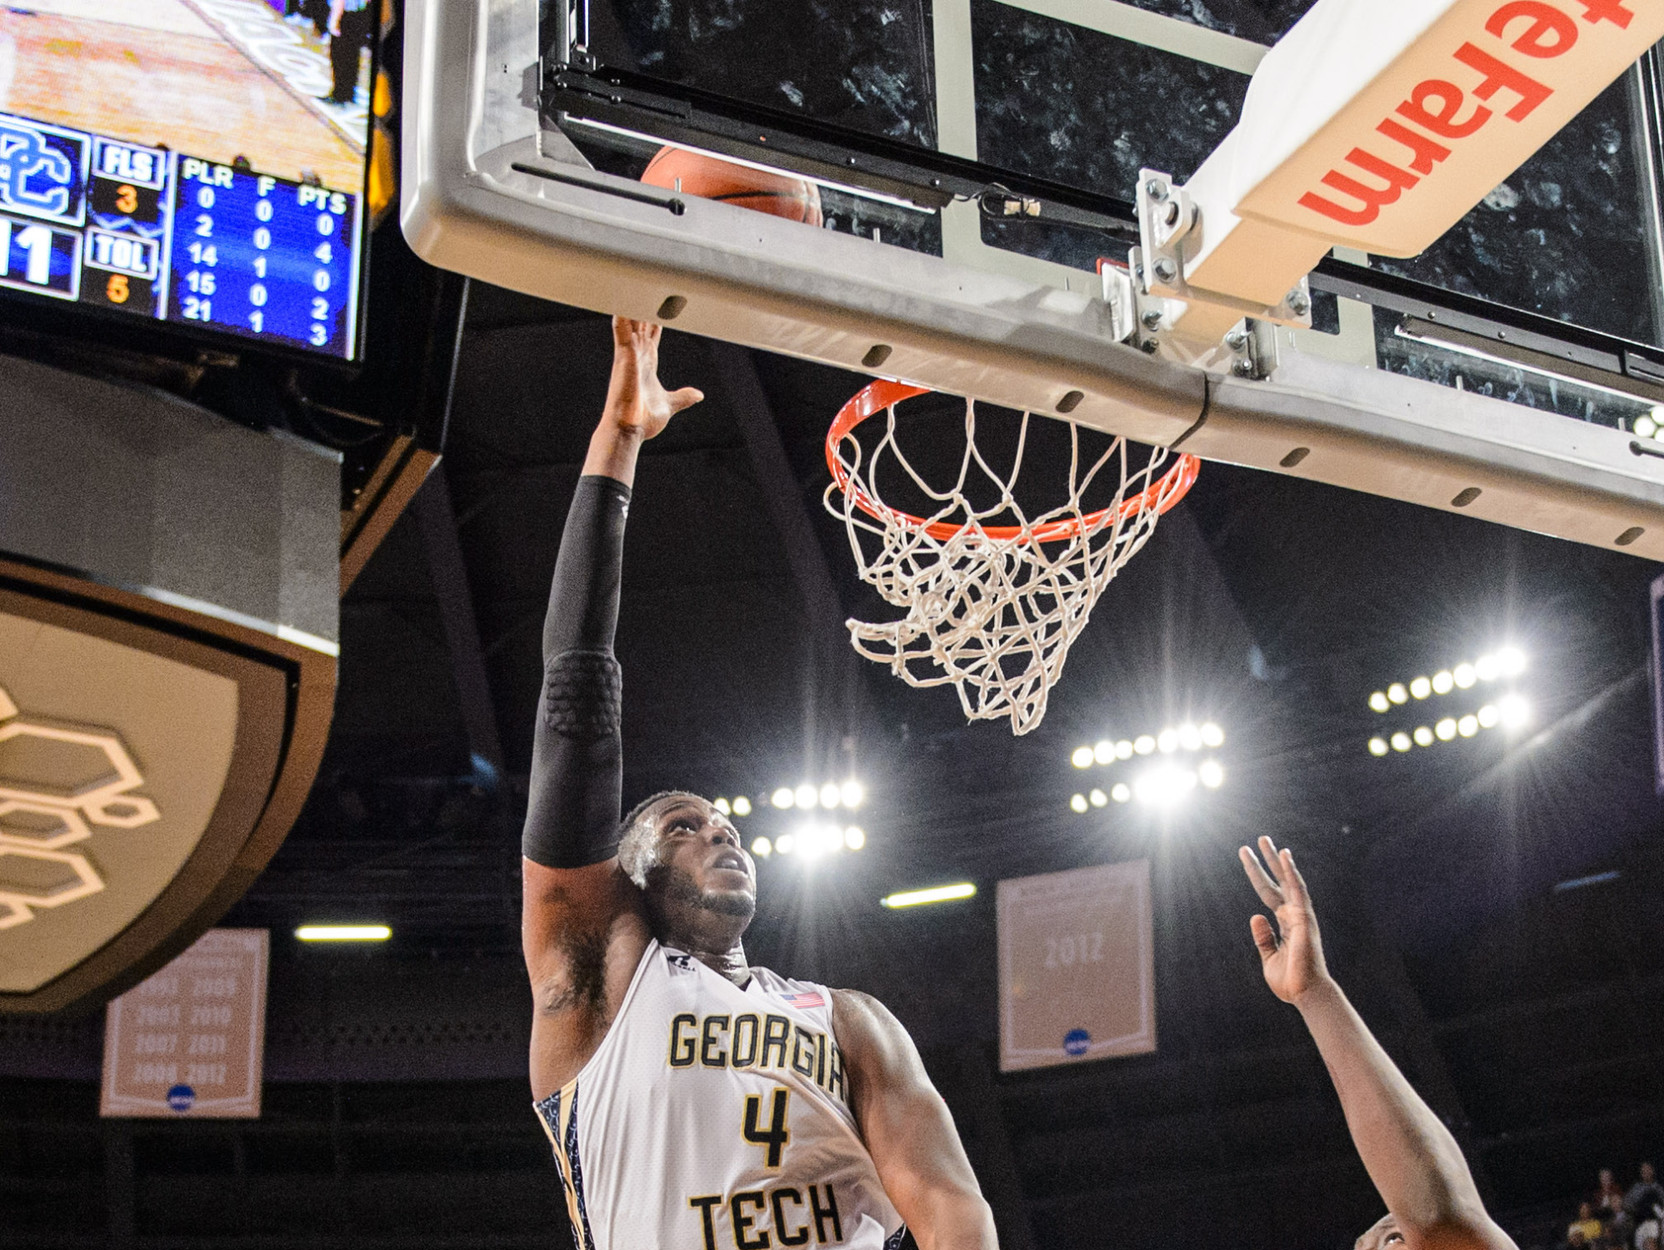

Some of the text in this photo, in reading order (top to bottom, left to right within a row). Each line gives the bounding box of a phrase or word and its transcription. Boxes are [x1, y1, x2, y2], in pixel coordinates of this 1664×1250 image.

[104, 145, 153, 182] FLS
[182, 157, 347, 215] PLR F PTS
[115, 184, 138, 214] 3
[197, 185, 334, 236] 0 0 0
[95, 233, 147, 273] TOL
[195, 213, 333, 264] 2 0 4
[106, 273, 130, 304] 5
[186, 240, 331, 292] 14 1 0
[183, 295, 328, 346] 21 1 3
[185, 269, 329, 321] 15 0 2
[669, 1012, 847, 1102] GEORGIA
[742, 1086, 790, 1170] 4
